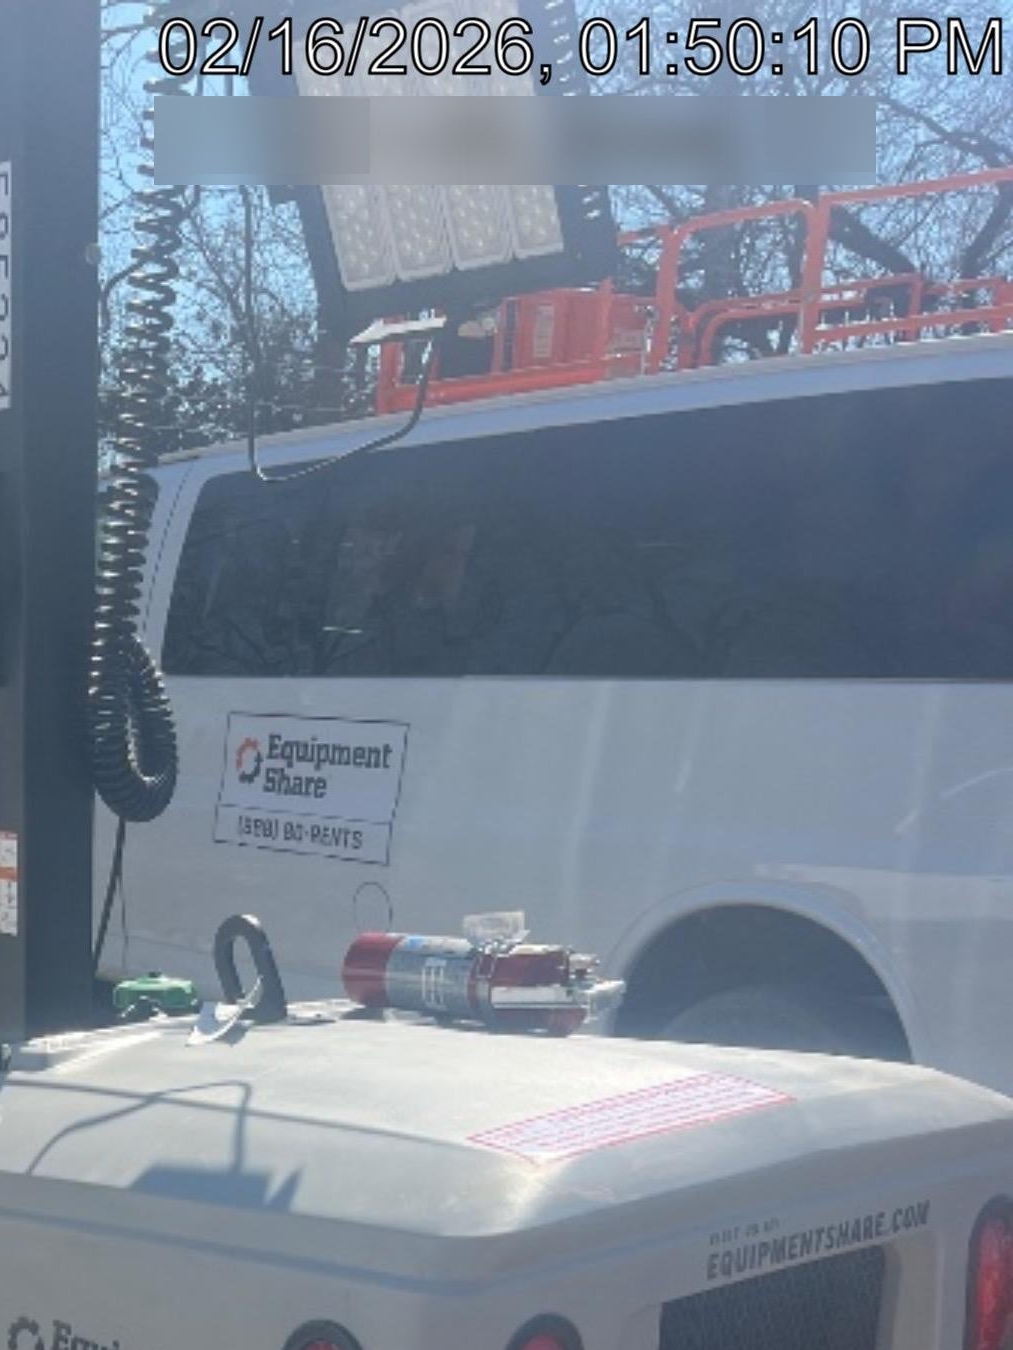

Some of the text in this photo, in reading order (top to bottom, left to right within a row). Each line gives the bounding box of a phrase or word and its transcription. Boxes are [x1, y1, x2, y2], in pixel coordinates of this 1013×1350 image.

[266, 734, 393, 771] Equipment
[262, 767, 328, 799] Share
[706, 1200, 930, 1281] EQUIPMENTSHARE.COM
